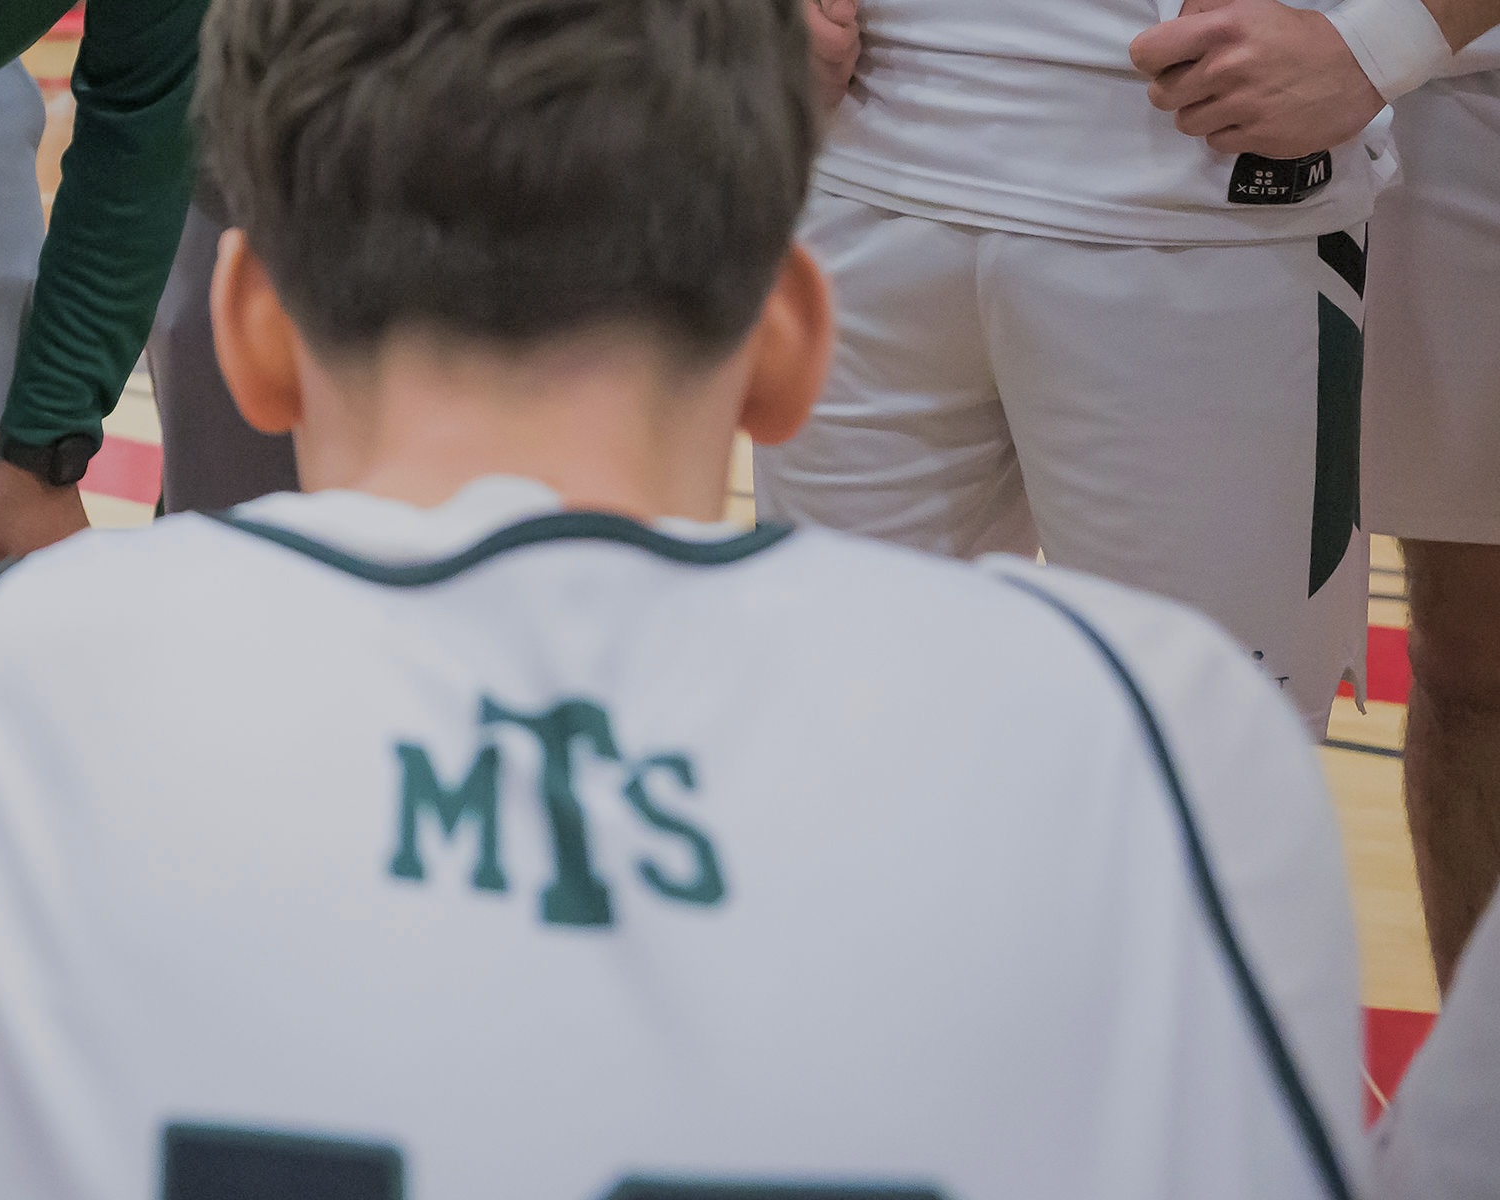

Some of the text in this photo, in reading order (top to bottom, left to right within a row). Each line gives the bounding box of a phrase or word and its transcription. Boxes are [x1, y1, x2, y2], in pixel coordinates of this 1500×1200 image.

[1307, 159, 1326, 187] M
[1236, 183, 1290, 196] XEIST
[391, 695, 726, 928] MTS
